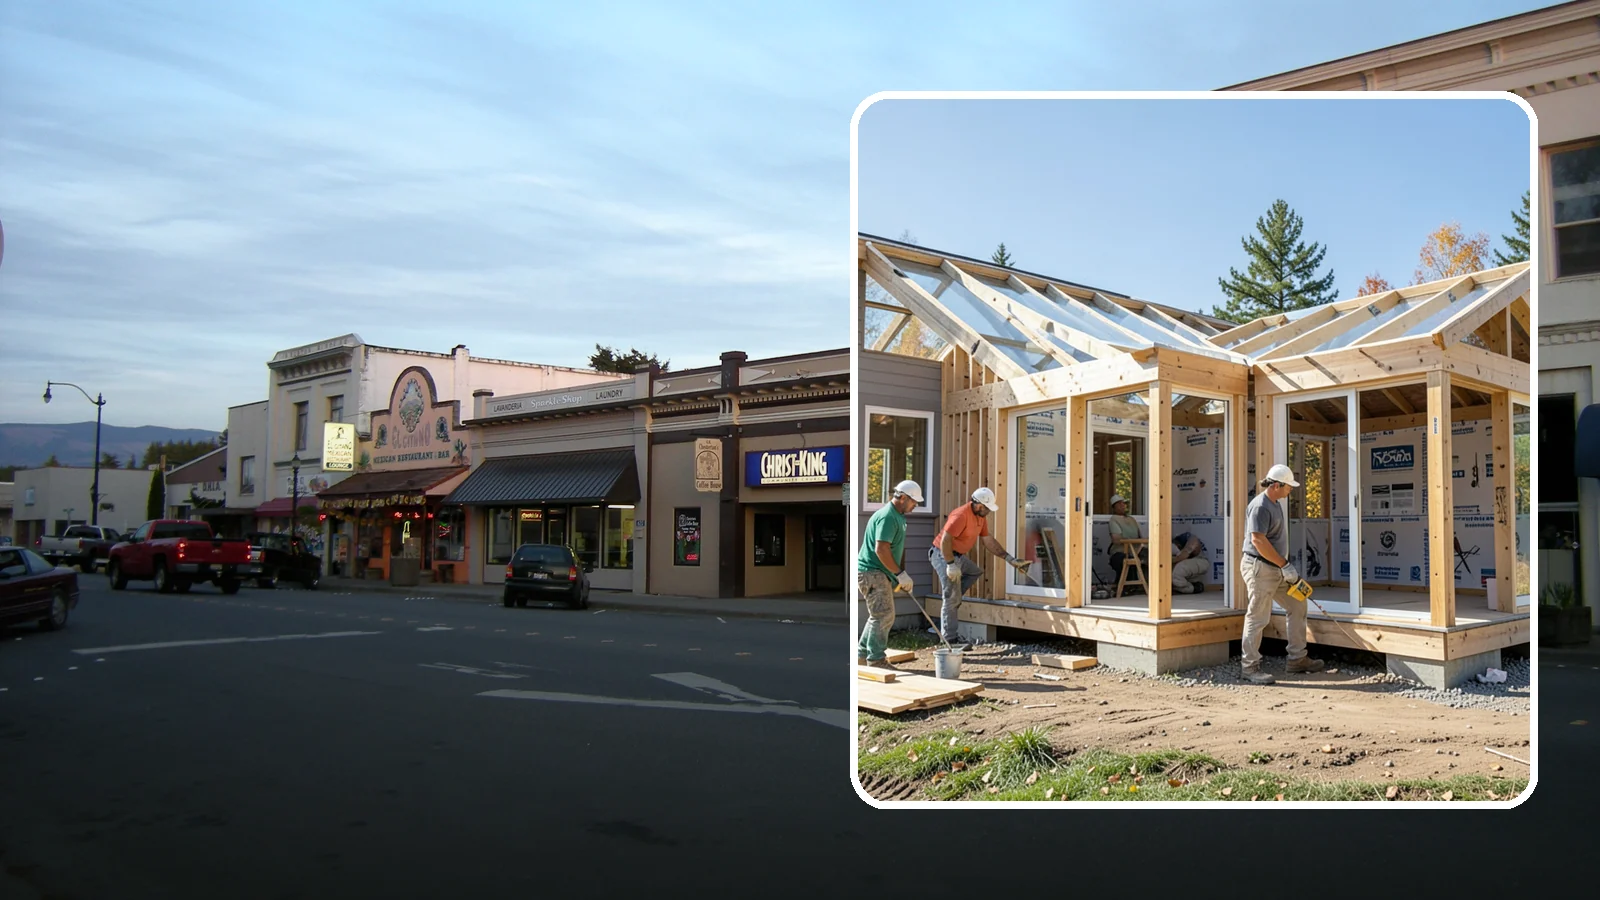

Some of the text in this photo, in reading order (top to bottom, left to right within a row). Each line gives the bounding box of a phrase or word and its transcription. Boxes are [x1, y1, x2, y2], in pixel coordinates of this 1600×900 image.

[531, 394, 582, 409] Sparkle Shop
[596, 389, 624, 400] LAUNDRY
[494, 402, 522, 412] LAVANDERIA
[373, 455, 396, 464] MEXICAN
[397, 451, 433, 462] RESTAURANT
[438, 450, 450, 458] BAR
[761, 450, 827, 478] CHRIST KING
